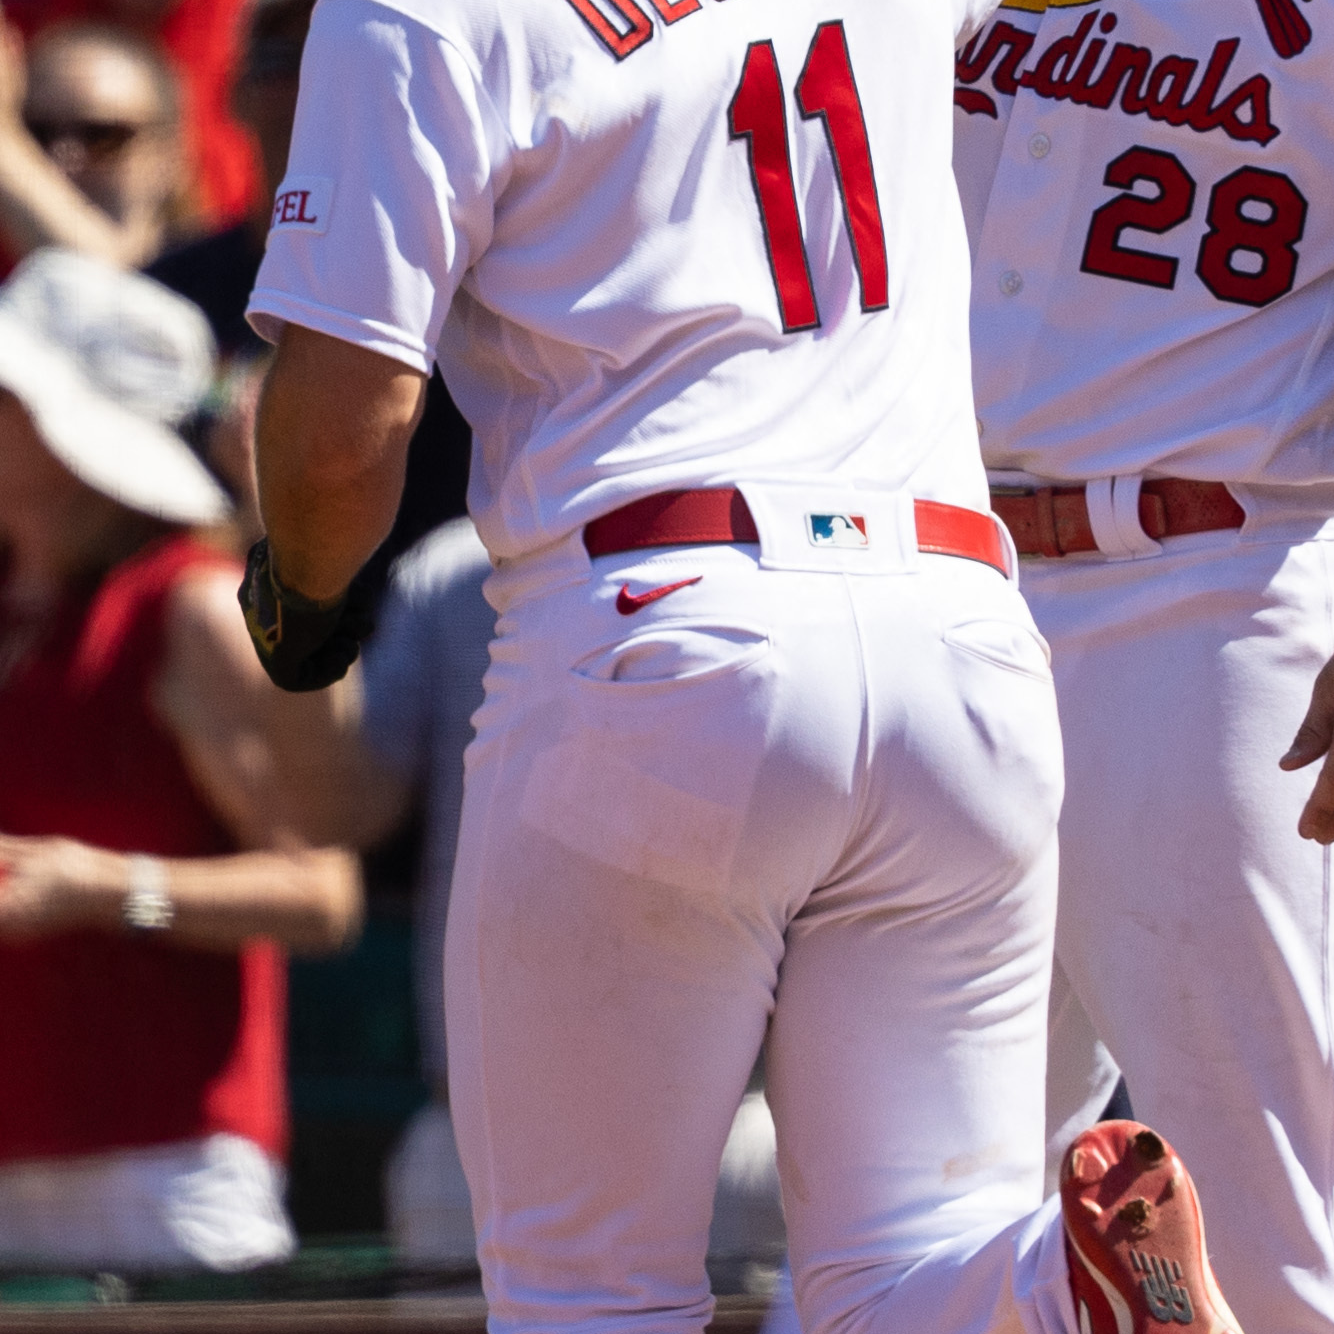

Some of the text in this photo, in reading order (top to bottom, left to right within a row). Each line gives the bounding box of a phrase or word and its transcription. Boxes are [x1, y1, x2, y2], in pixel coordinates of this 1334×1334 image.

[953, 8, 1281, 148] ardinals
[726, 18, 889, 335] 11
[1079, 144, 1308, 308] 28
